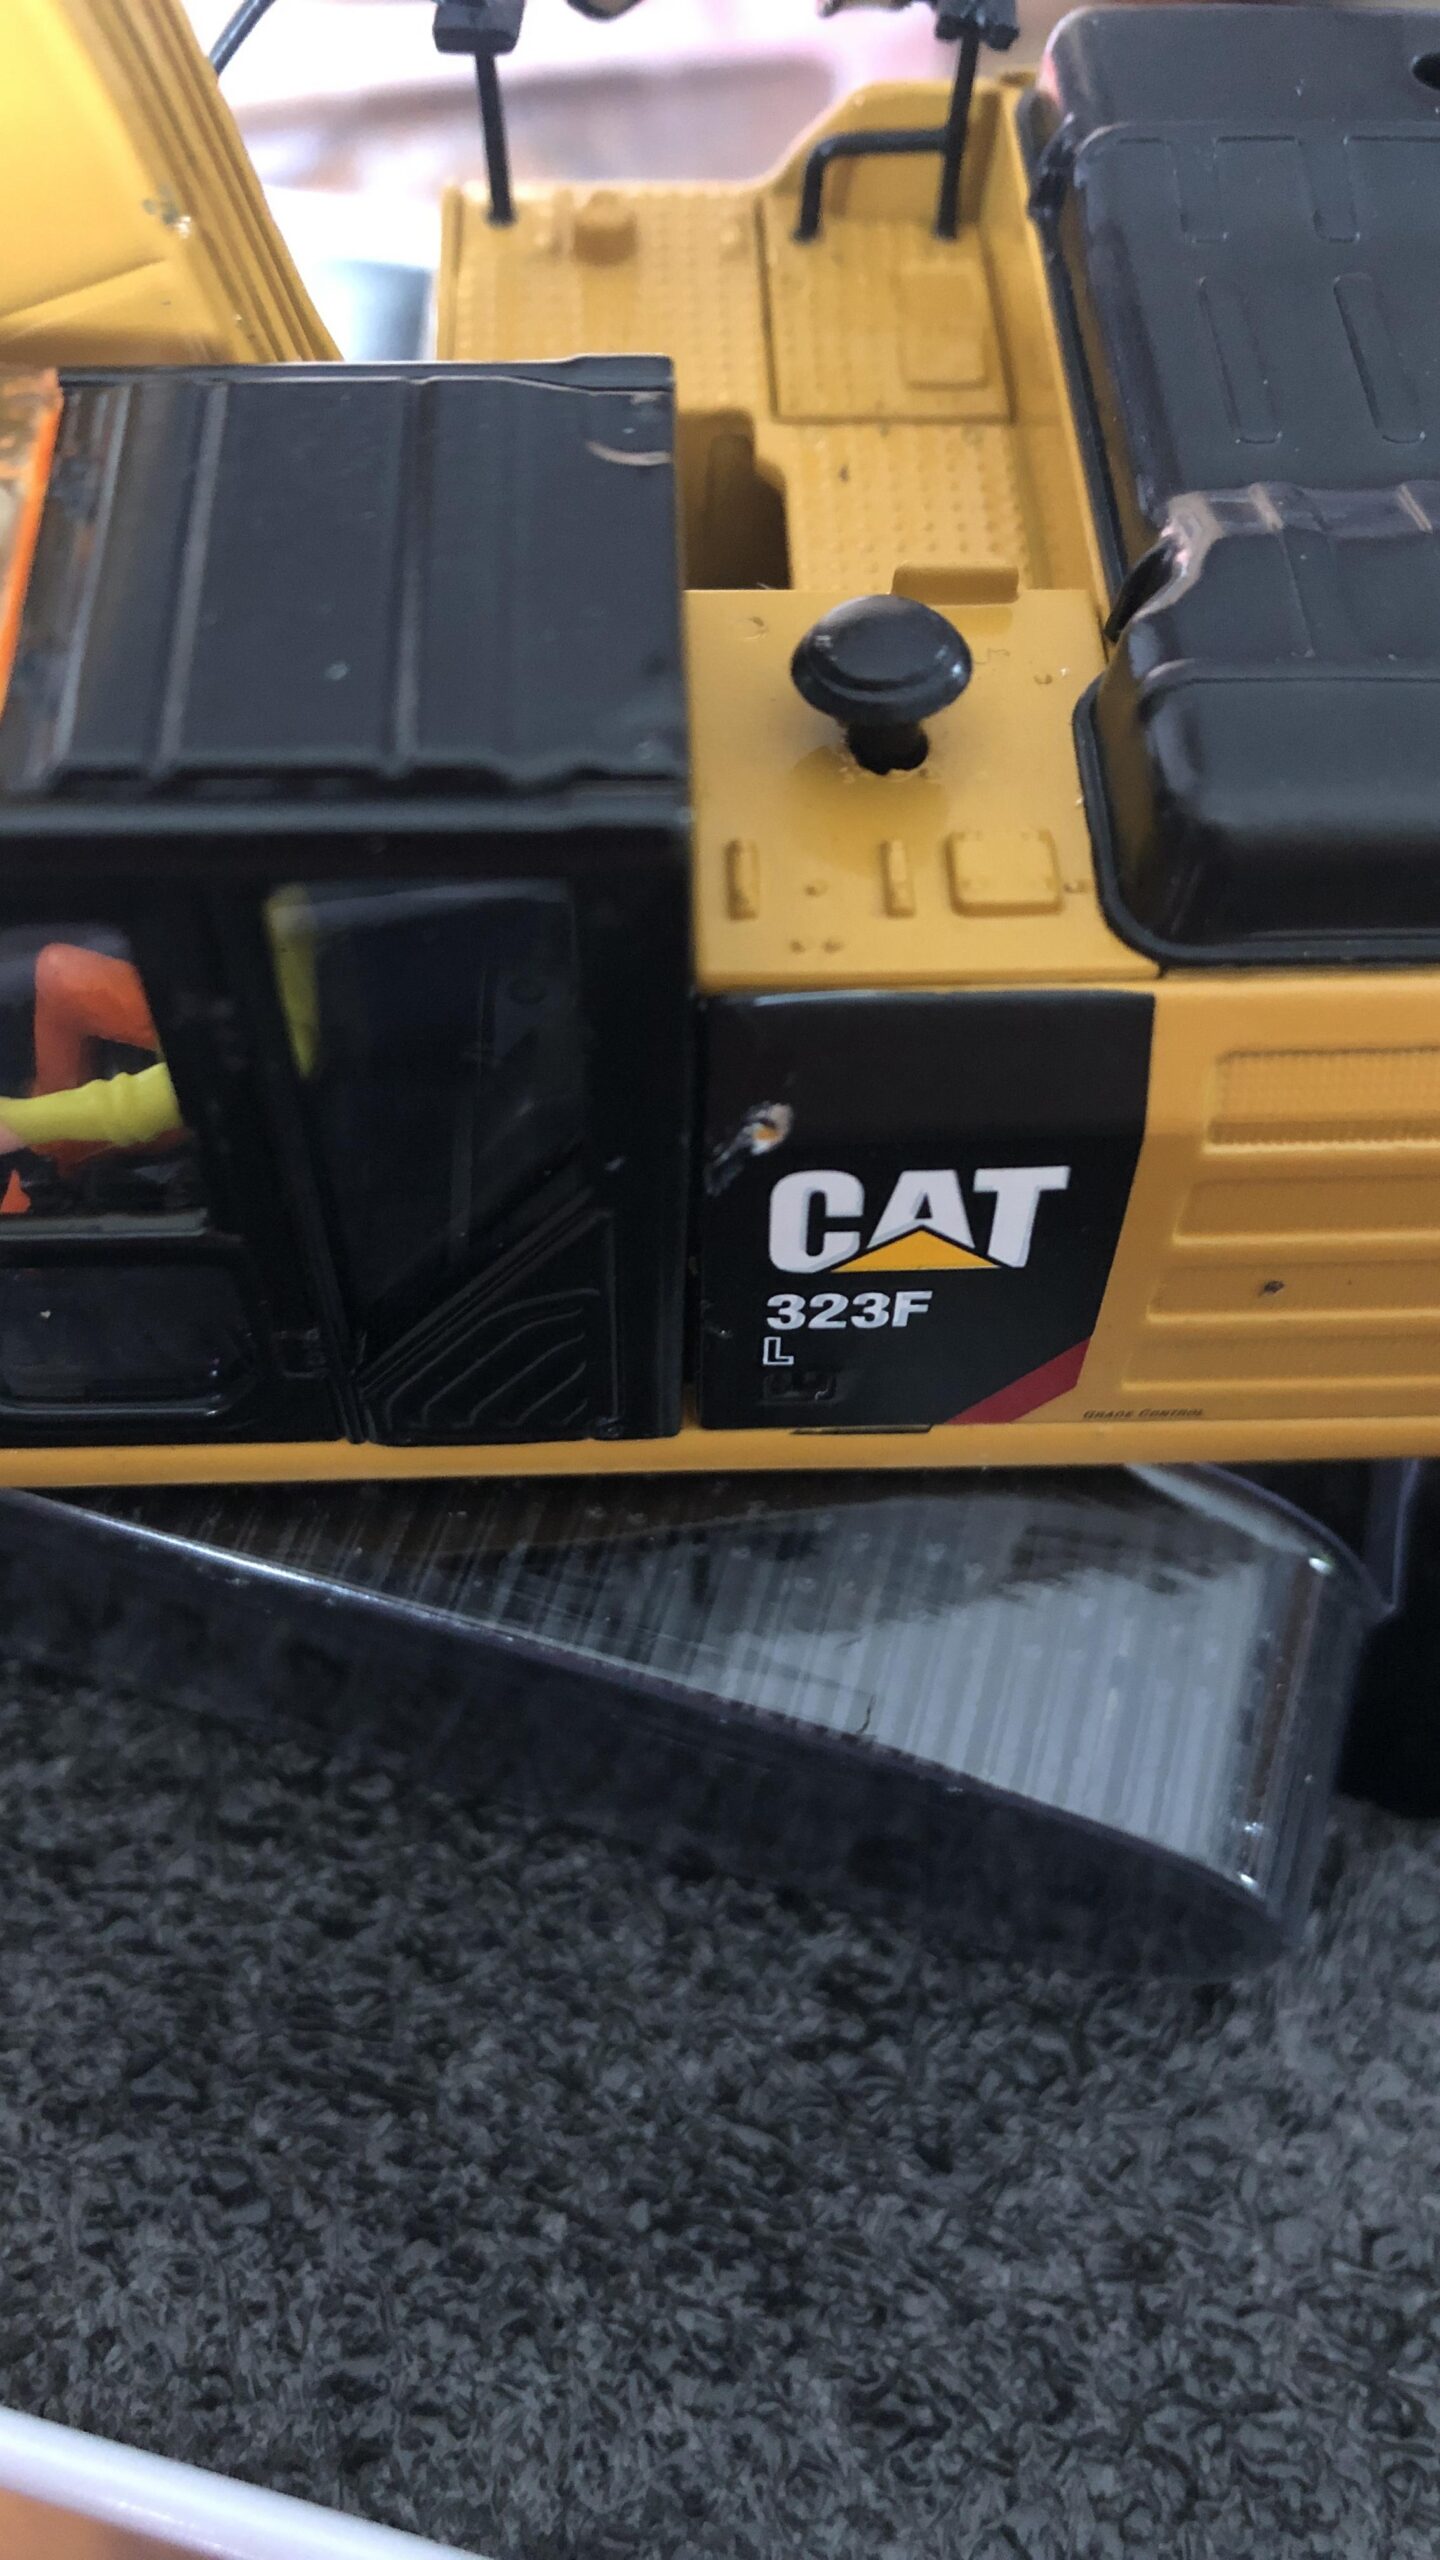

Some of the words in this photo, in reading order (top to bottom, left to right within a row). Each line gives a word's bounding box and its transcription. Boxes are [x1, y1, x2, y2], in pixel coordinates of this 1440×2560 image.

[769, 1166, 1071, 1274] CAT
[766, 1290, 933, 1331] 323F
[763, 1336, 795, 1366] L
